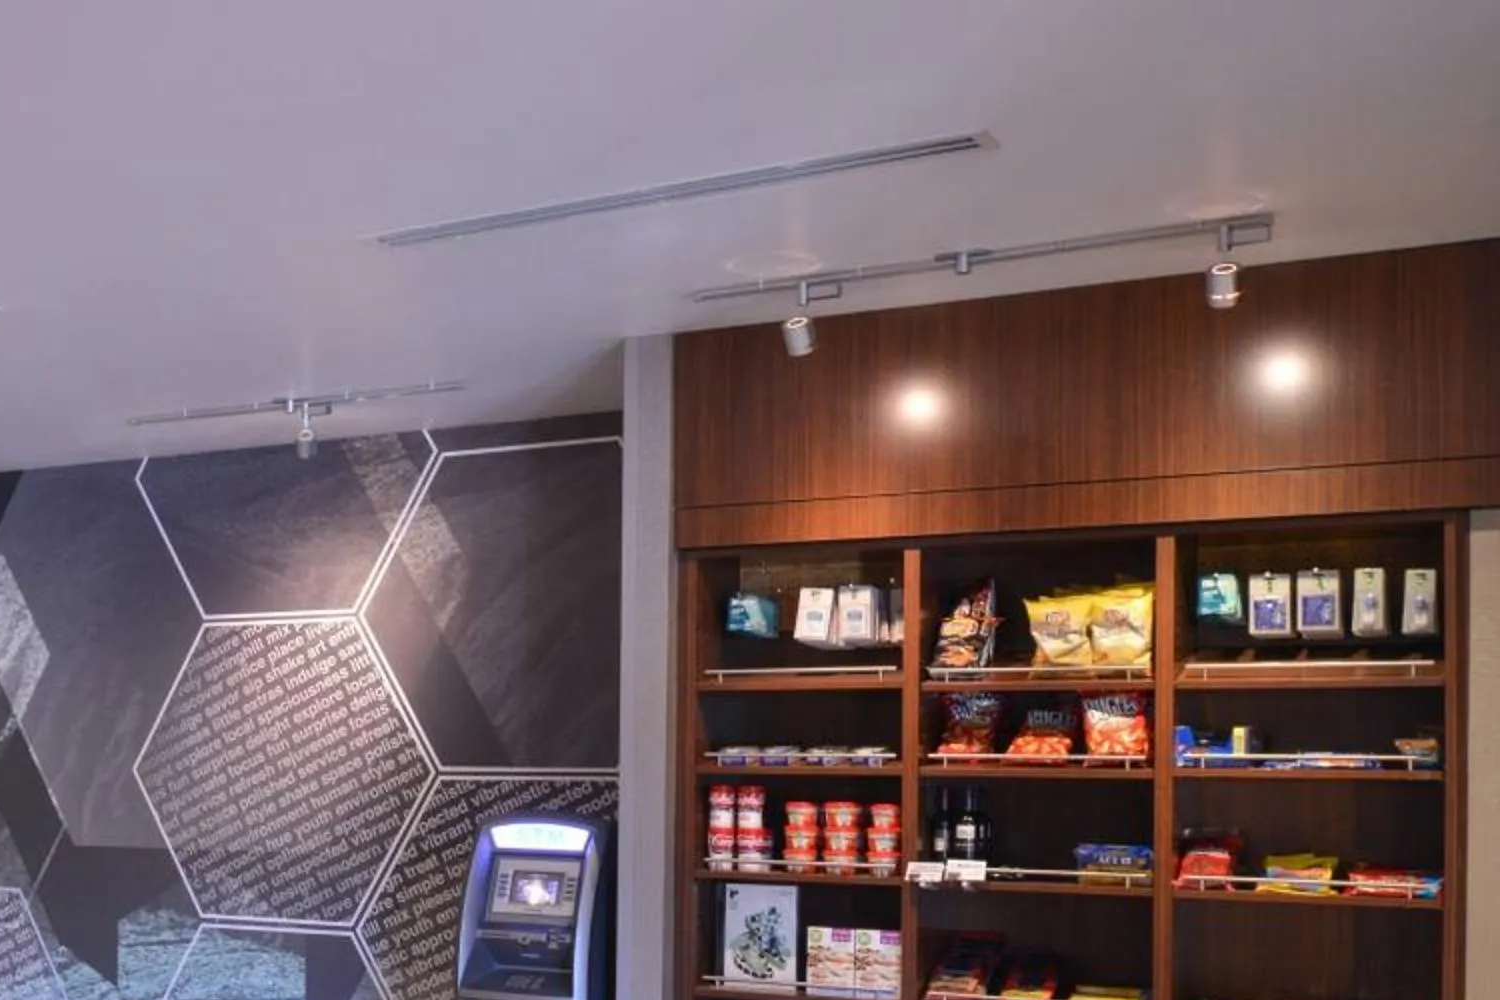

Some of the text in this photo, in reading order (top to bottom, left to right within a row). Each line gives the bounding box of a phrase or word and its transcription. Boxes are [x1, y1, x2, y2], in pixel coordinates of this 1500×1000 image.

[203, 637, 265, 683] springhill
[266, 625, 291, 645] mix
[205, 691, 239, 718] savor
[242, 677, 264, 697] sip
[265, 654, 305, 683] shake
[307, 640, 328, 659] art
[226, 656, 266, 687] entice
[267, 635, 305, 670] place
[243, 685, 284, 714] extras
[283, 655, 337, 690] indulge
[175, 737, 222, 772] explore
[222, 719, 256, 744] local
[257, 667, 349, 727] spaciousness
[190, 746, 245, 780] surprise
[245, 717, 291, 750] delight
[293, 690, 345, 723] explore
[161, 773, 227, 816] rejuvenate
[227, 750, 266, 778] focus
[265, 738, 290, 757] fun
[291, 704, 349, 743] surprise
[181, 791, 228, 823] service
[229, 766, 276, 797] refresh
[276, 725, 349, 769] rejuvenate
[347, 703, 390, 731] focus
[199, 803, 239, 832] space
[239, 770, 296, 812] polished
[297, 744, 348, 779] service
[348, 718, 401, 751] refresh
[188, 847, 226, 876] youth
[226, 801, 310, 853] environment
[310, 778, 360, 810] human
[361, 758, 396, 786] style
[198, 819, 243, 850] human
[244, 802, 277, 827] style
[278, 780, 320, 807] shake
[321, 756, 363, 785] space
[205, 846, 265, 884] approach
[265, 831, 293, 852] hue
[293, 810, 334, 848] youth
[335, 762, 424, 817] environment
[218, 863, 266, 895] vibrant
[265, 829, 333, 872] optimistic
[334, 794, 401, 838] approach
[270, 837, 349, 888] unexpected
[348, 812, 402, 845] vibrant
[404, 854, 441, 881] treat
[442, 836, 474, 863] mod
[420, 818, 472, 853] vibrant
[270, 876, 318, 908] design
[281, 887, 335, 918] modern
[321, 898, 354, 918] love
[396, 874, 446, 904] simple
[383, 909, 412, 929] mix
[391, 916, 435, 949] youth
[410, 927, 457, 958] appro
